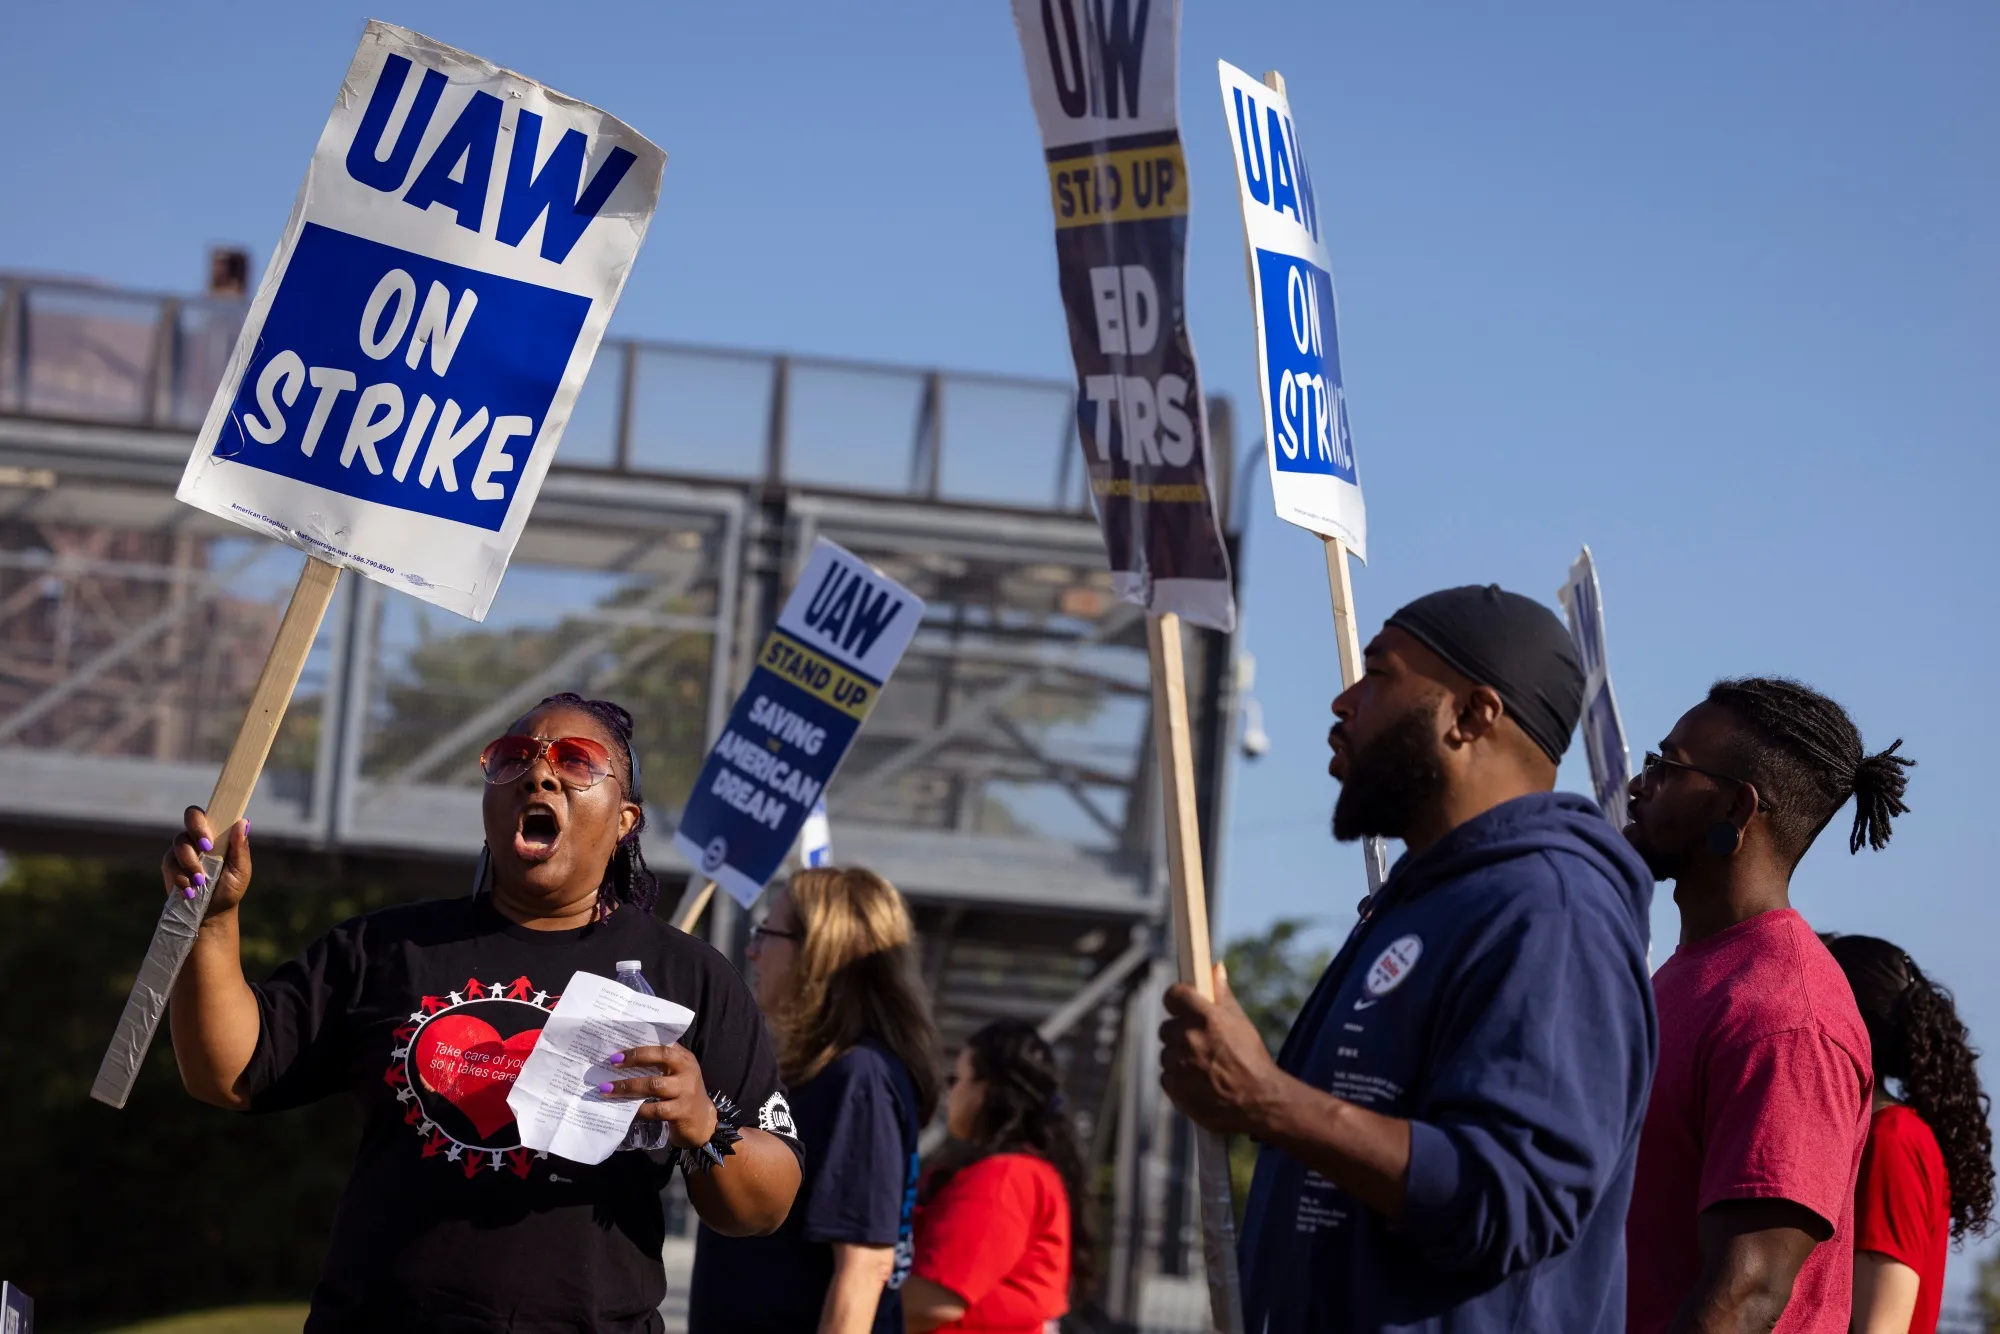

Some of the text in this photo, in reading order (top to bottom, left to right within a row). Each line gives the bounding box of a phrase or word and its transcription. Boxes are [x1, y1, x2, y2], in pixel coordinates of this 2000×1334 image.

[346, 52, 638, 265] UAW
[1132, 157, 1175, 209] UP
[1232, 86, 1319, 245] UAW
[359, 268, 478, 377] ON
[1288, 265, 1324, 359] ON
[243, 349, 533, 501] STRIKE
[1278, 368, 1352, 471] STRIKE
[231, 503, 261, 519] American
[261, 515, 289, 532] Graphics
[352, 554, 395, 574] 586.790.8500
[803, 560, 903, 660] UAW
[766, 640, 868, 708] STAND UP
[748, 695, 827, 756] SAVING
[711, 768, 787, 830] DREAM
[714, 730, 822, 808] AMERICAN
[429, 1059, 517, 1083] so it takes care
[435, 1041, 462, 1058] Take
[464, 1051, 490, 1063] care
[493, 1054, 508, 1065] of
[772, 1110, 791, 1128] UAW
